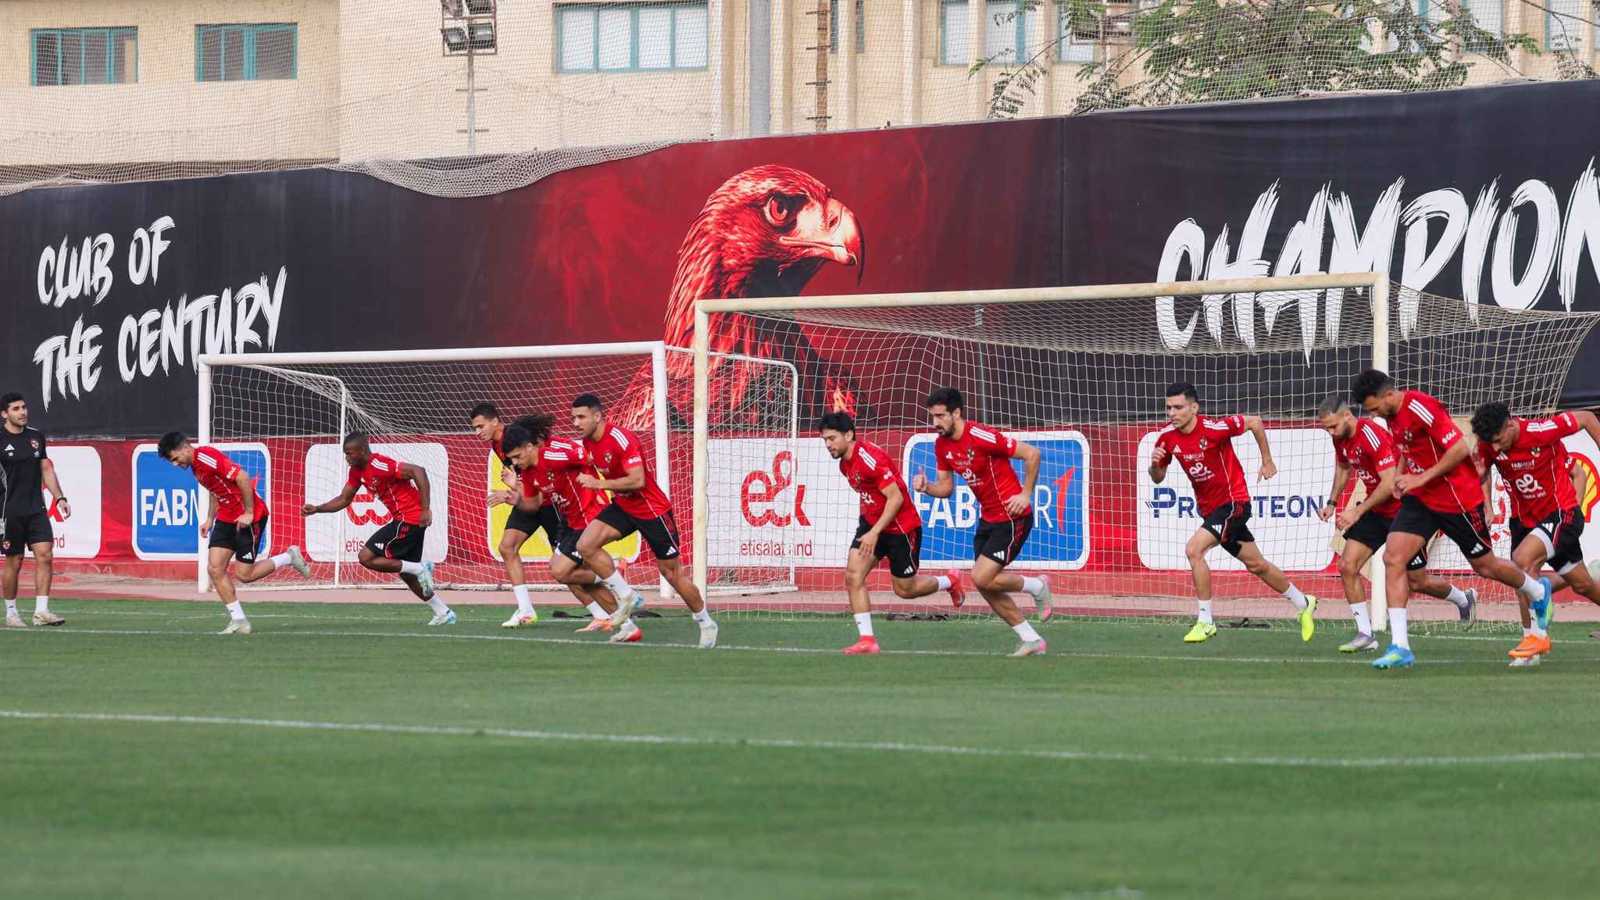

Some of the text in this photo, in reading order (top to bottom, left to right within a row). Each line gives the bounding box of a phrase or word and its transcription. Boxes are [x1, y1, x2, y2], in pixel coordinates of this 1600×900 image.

[37, 215, 176, 308] CLUB OF
[33, 265, 288, 413] THE CENTURY
[787, 538, 813, 557] nd
